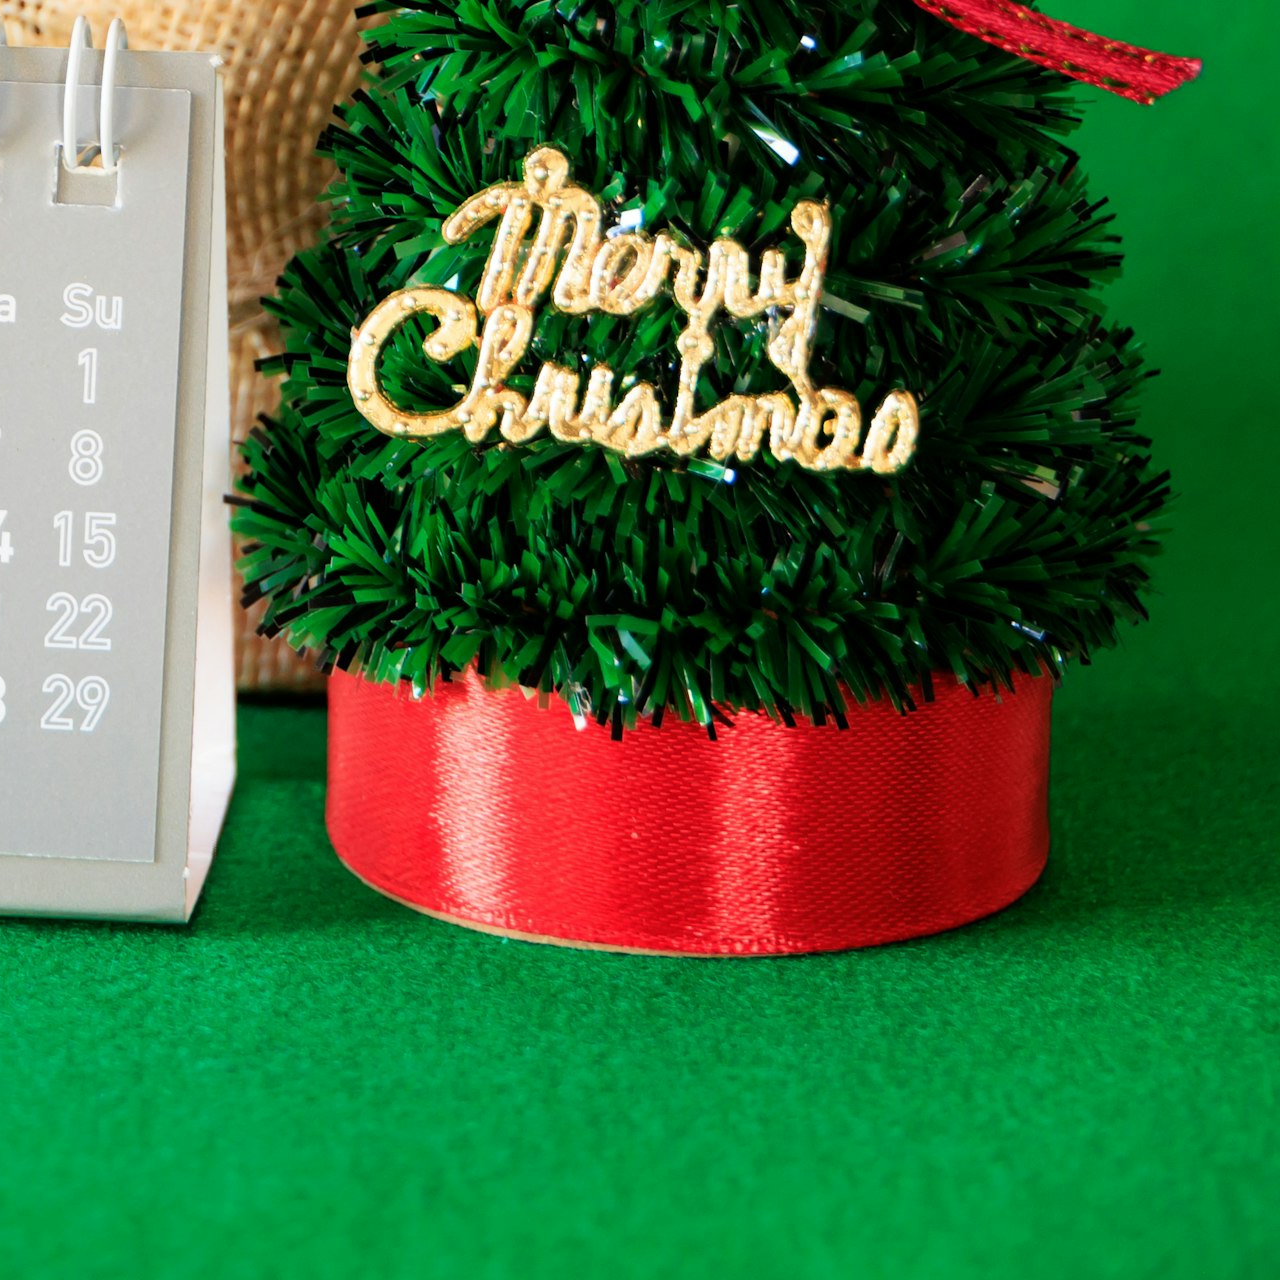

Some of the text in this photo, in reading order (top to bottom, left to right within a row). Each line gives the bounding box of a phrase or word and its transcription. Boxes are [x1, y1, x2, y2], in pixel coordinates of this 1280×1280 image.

[442, 144, 830, 377] Merry
[60, 283, 122, 329] Su
[78, 348, 97, 403] 1
[347, 286, 919, 474] Christmas
[69, 430, 103, 485] 8
[54, 511, 116, 568] 15
[44, 592, 112, 650] 22
[41, 674, 110, 731] 29
